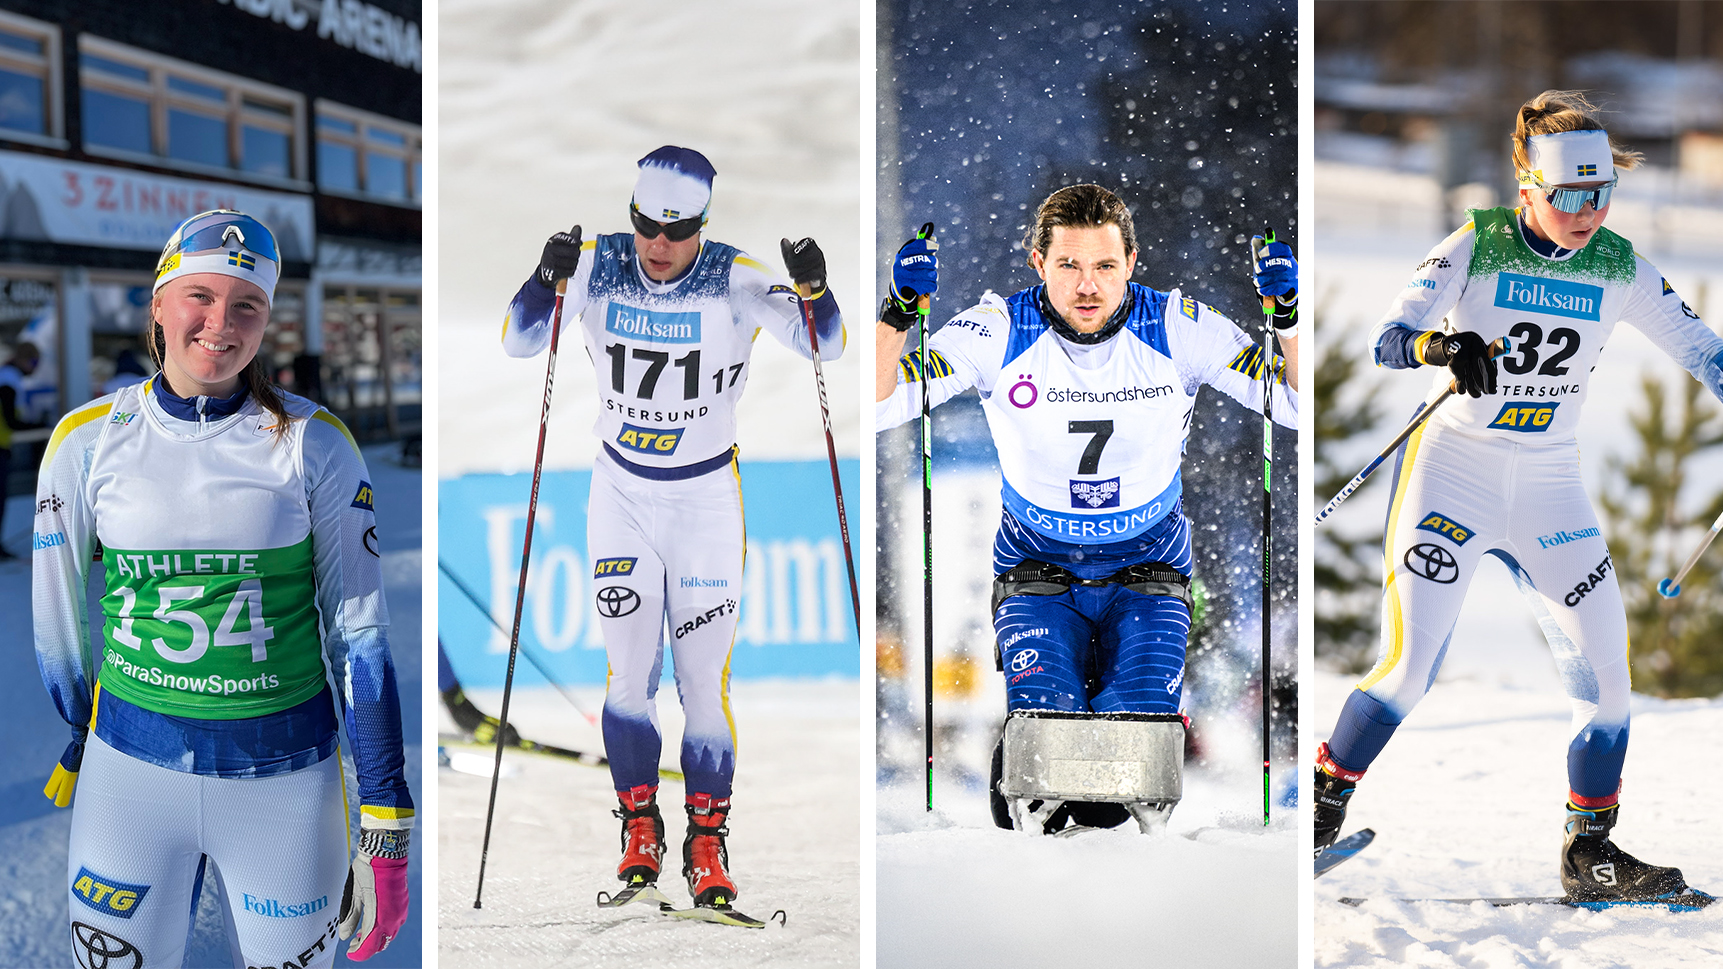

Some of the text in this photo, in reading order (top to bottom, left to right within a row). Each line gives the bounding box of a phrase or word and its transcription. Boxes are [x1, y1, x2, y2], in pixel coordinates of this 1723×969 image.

[900, 254, 931, 267] HESTRA
[1265, 257, 1293, 269] HESTRA
[1595, 245, 1621, 257] WORLD
[1506, 279, 1594, 314] Folksam
[1182, 298, 1195, 320] AT
[613, 310, 693, 339] Folksam
[945, 318, 981, 332] RAFT
[1502, 321, 1581, 377] 32
[605, 343, 701, 401] 171
[1047, 383, 1174, 403] östersundshem
[1498, 384, 1580, 397] TERSUND
[606, 399, 709, 422] STERSUND
[1495, 407, 1553, 427] ATG
[619, 429, 677, 451] ATG
[1068, 419, 1114, 475] 7
[355, 486, 374, 506] AT
[1026, 501, 1162, 538] ÖSTERSUND
[1422, 515, 1468, 542] ATG
[1536, 526, 1601, 550] Folksam
[116, 553, 259, 580] ATHLETE
[595, 560, 633, 576] ATG
[680, 576, 728, 589] Folksam
[1564, 556, 1613, 608] CRAFT
[112, 578, 275, 665] 154
[675, 604, 726, 640] CRAFT
[1003, 627, 1049, 652] Folksam
[106, 649, 280, 696] @ParaSnowSports
[1011, 665, 1045, 685] TOYOTA
[74, 873, 139, 912] ATG
[242, 892, 329, 918] Folksam
